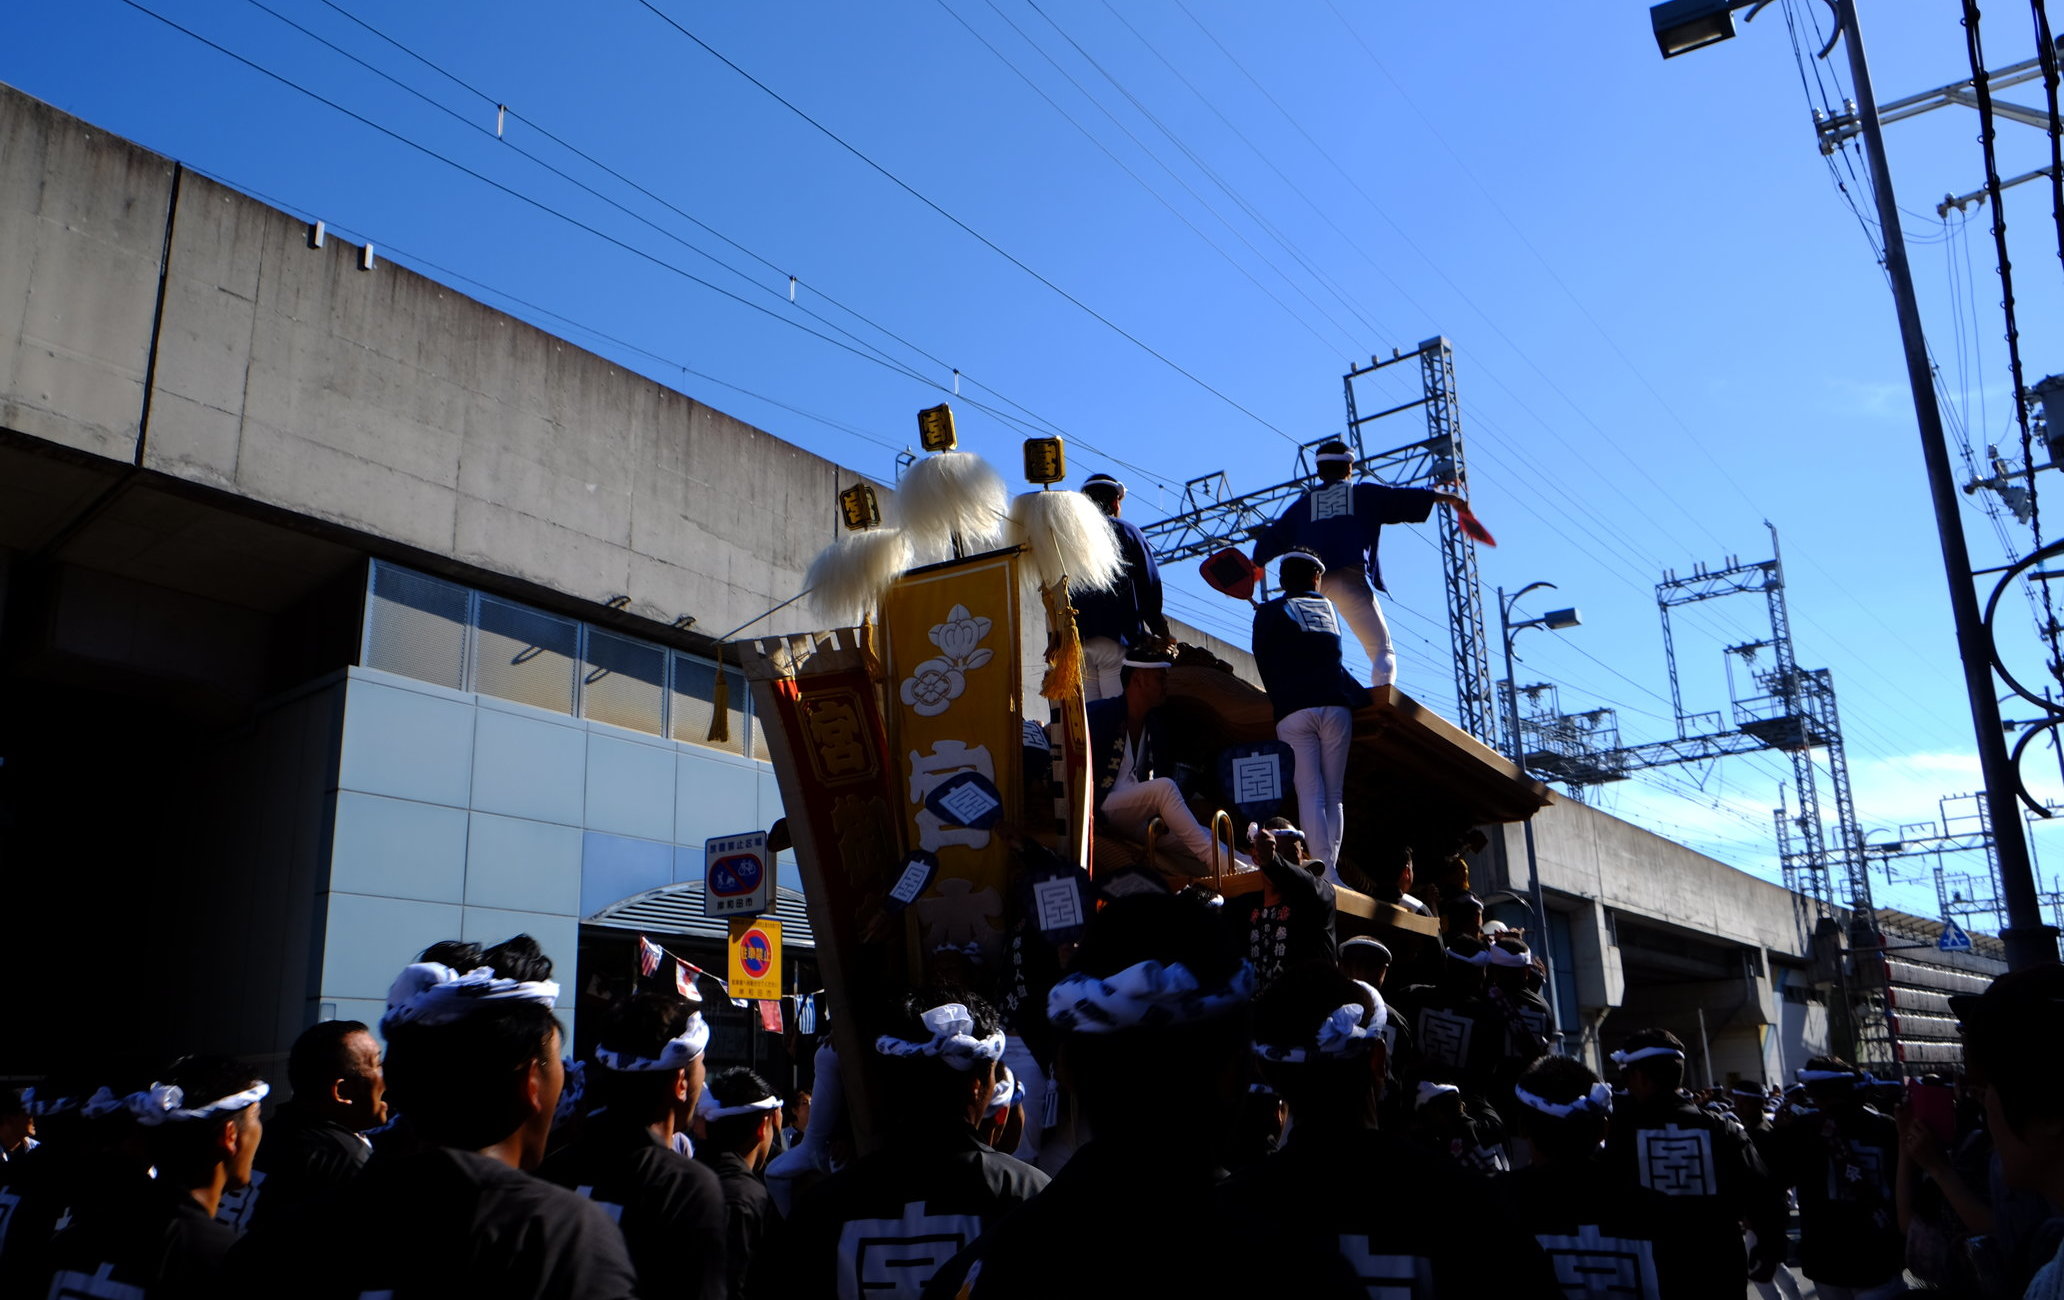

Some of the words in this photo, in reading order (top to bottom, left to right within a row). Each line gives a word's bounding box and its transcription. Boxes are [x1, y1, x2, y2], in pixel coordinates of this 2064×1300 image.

[710, 837, 762, 854] 放置禁止区域
[717, 897, 753, 910] 岸和田市
